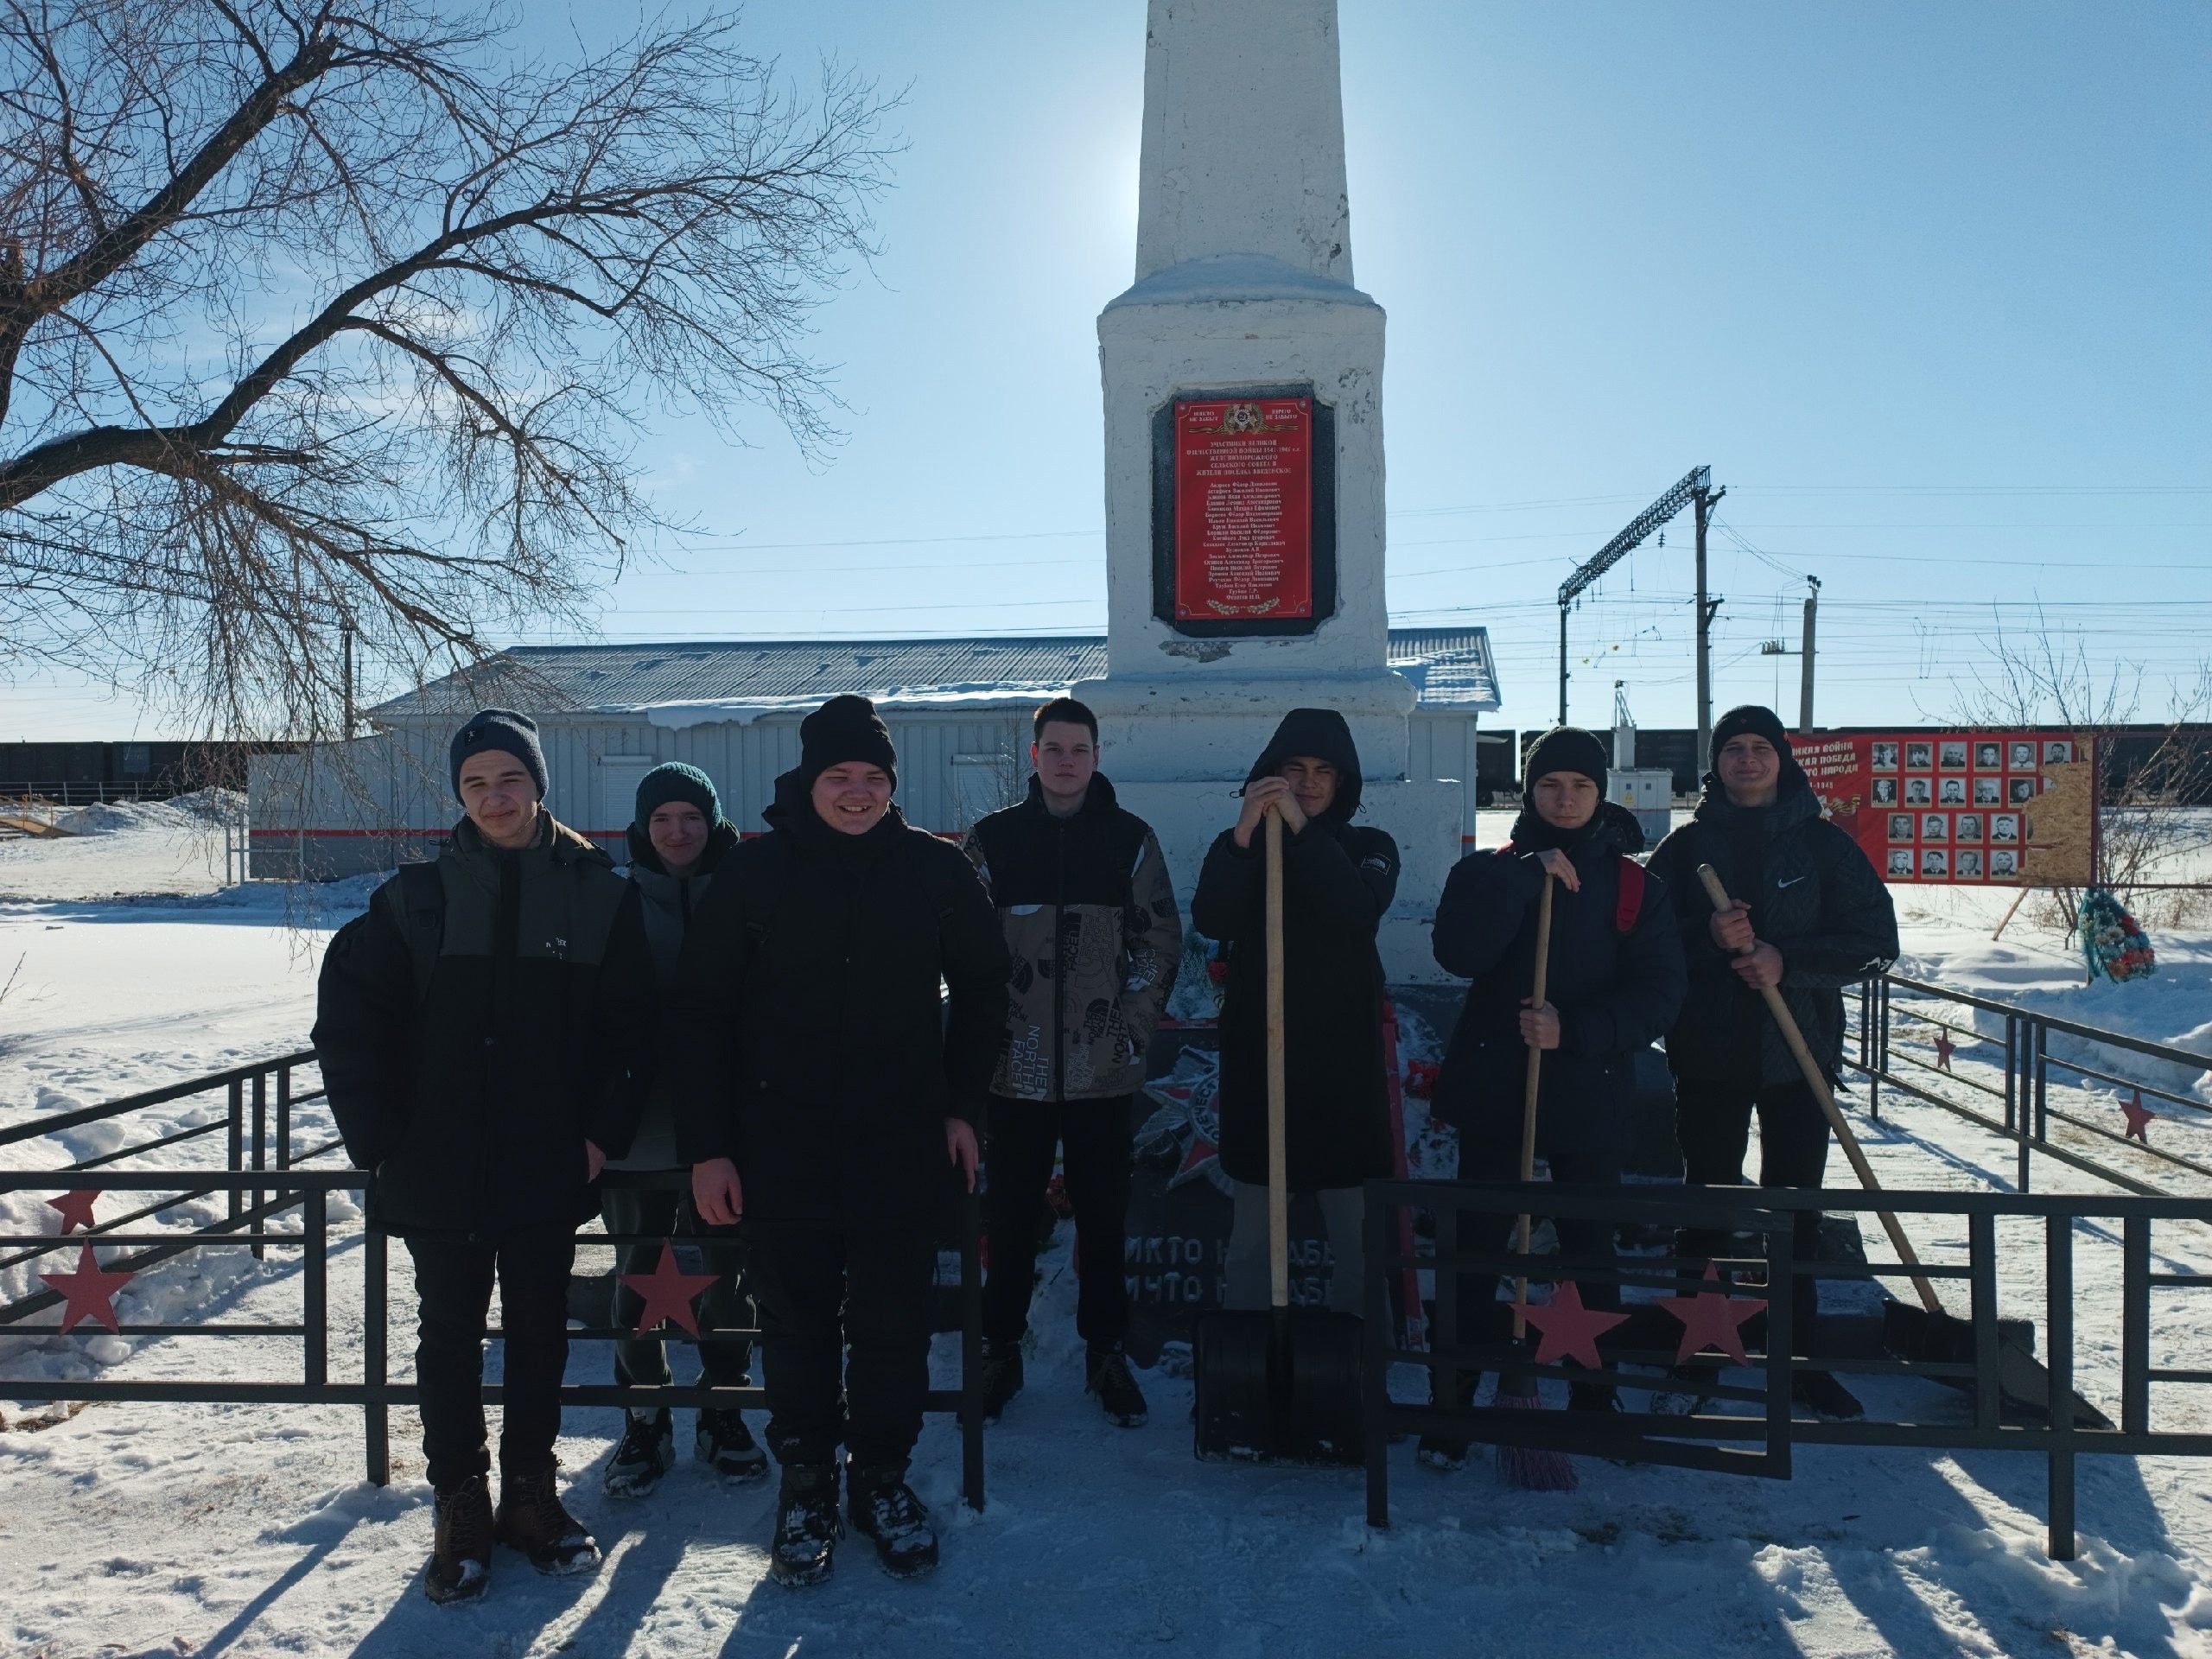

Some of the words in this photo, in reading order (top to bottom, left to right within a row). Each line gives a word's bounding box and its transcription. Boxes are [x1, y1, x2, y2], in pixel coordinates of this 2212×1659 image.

[1796, 757, 1817, 766] КАЯ
[1820, 753, 1856, 764] ПОБЕДА
[1822, 741, 1853, 753] ВОЙНА
[1821, 764, 1859, 776] НАРОДА
[1106, 1008, 1122, 1037] THE
[1011, 1039, 1026, 1085] FACE
[1022, 1025, 1042, 1085] NORTH
[1035, 1056, 1051, 1087] THE
[1123, 1235, 1204, 1266] ИКТО
[1123, 1271, 1204, 1304] ИЧТО
